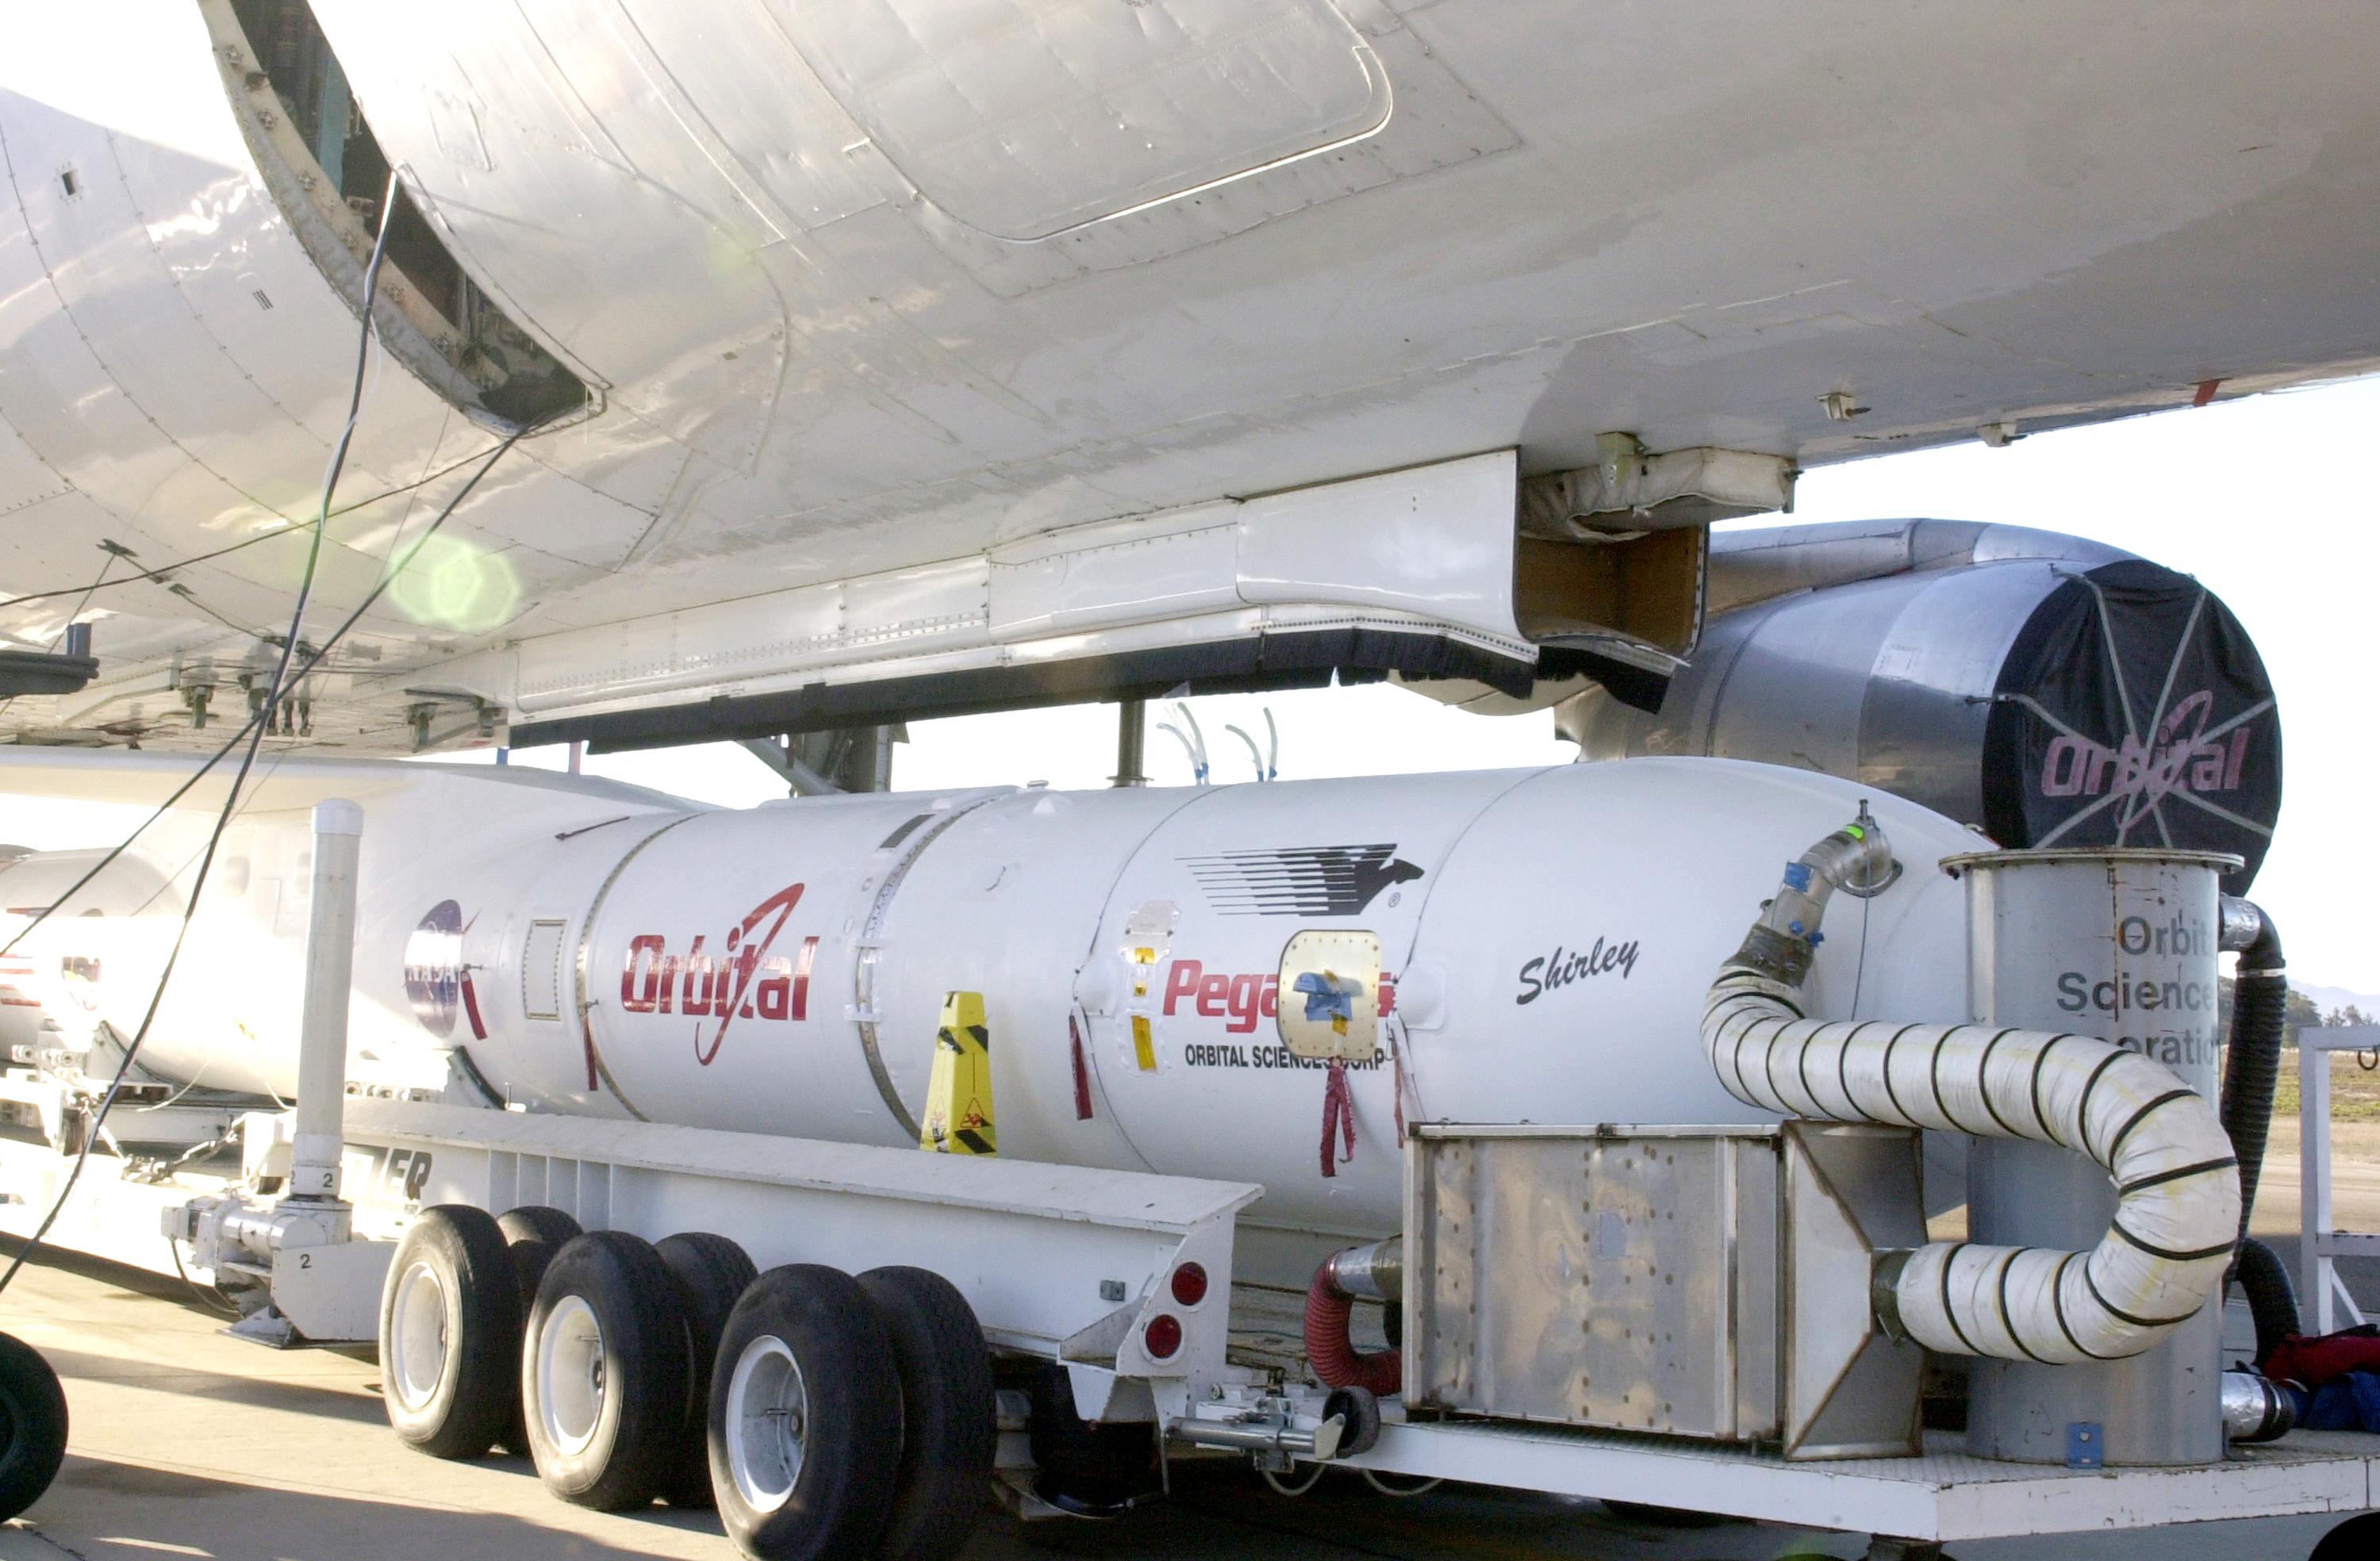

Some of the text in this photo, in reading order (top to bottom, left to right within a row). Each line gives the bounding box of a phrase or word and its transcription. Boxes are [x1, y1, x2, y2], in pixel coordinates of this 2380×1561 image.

[621, 883, 820, 1065] Orbital
[1516, 936, 1640, 1005] Shirley
[1185, 1044, 1249, 1068] ORBITAL
[323, 1172, 333, 1188] 2
[300, 1253, 312, 1269] 2
